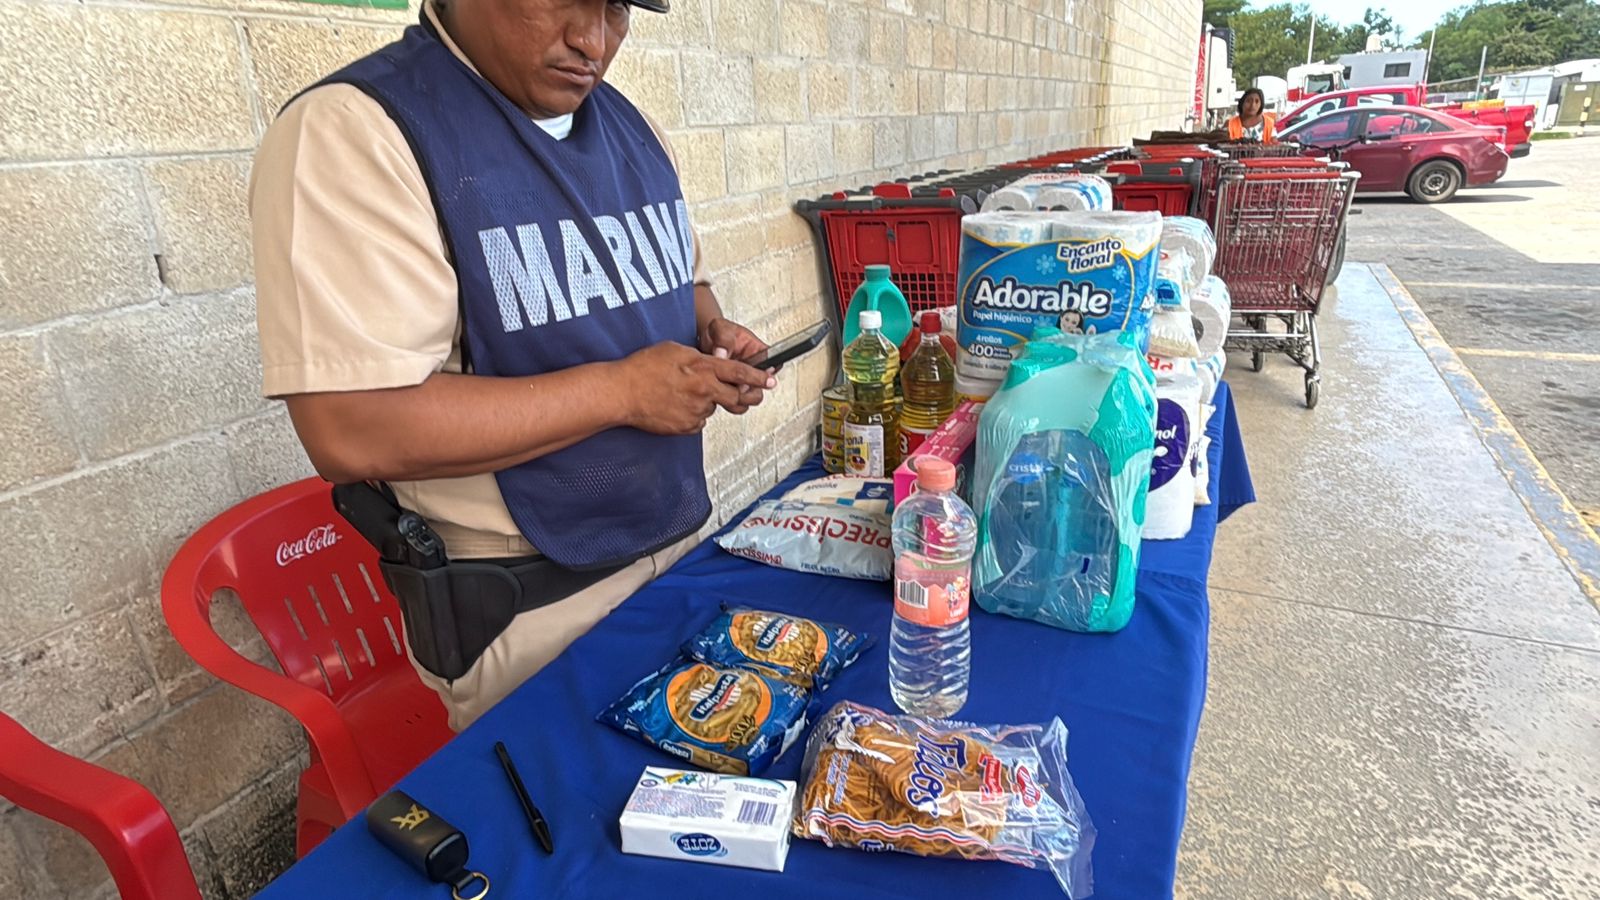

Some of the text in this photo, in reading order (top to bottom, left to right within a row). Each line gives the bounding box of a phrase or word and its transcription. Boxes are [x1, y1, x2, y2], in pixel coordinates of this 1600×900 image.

[1060, 238, 1122, 258] Encanto
[1070, 250, 1111, 271] floral
[973, 279, 1108, 315] Adorable
[973, 310, 993, 322] Papel
[968, 343, 993, 358] 400
[905, 732, 968, 818] Fideos
[680, 838, 718, 852] ZOTE
